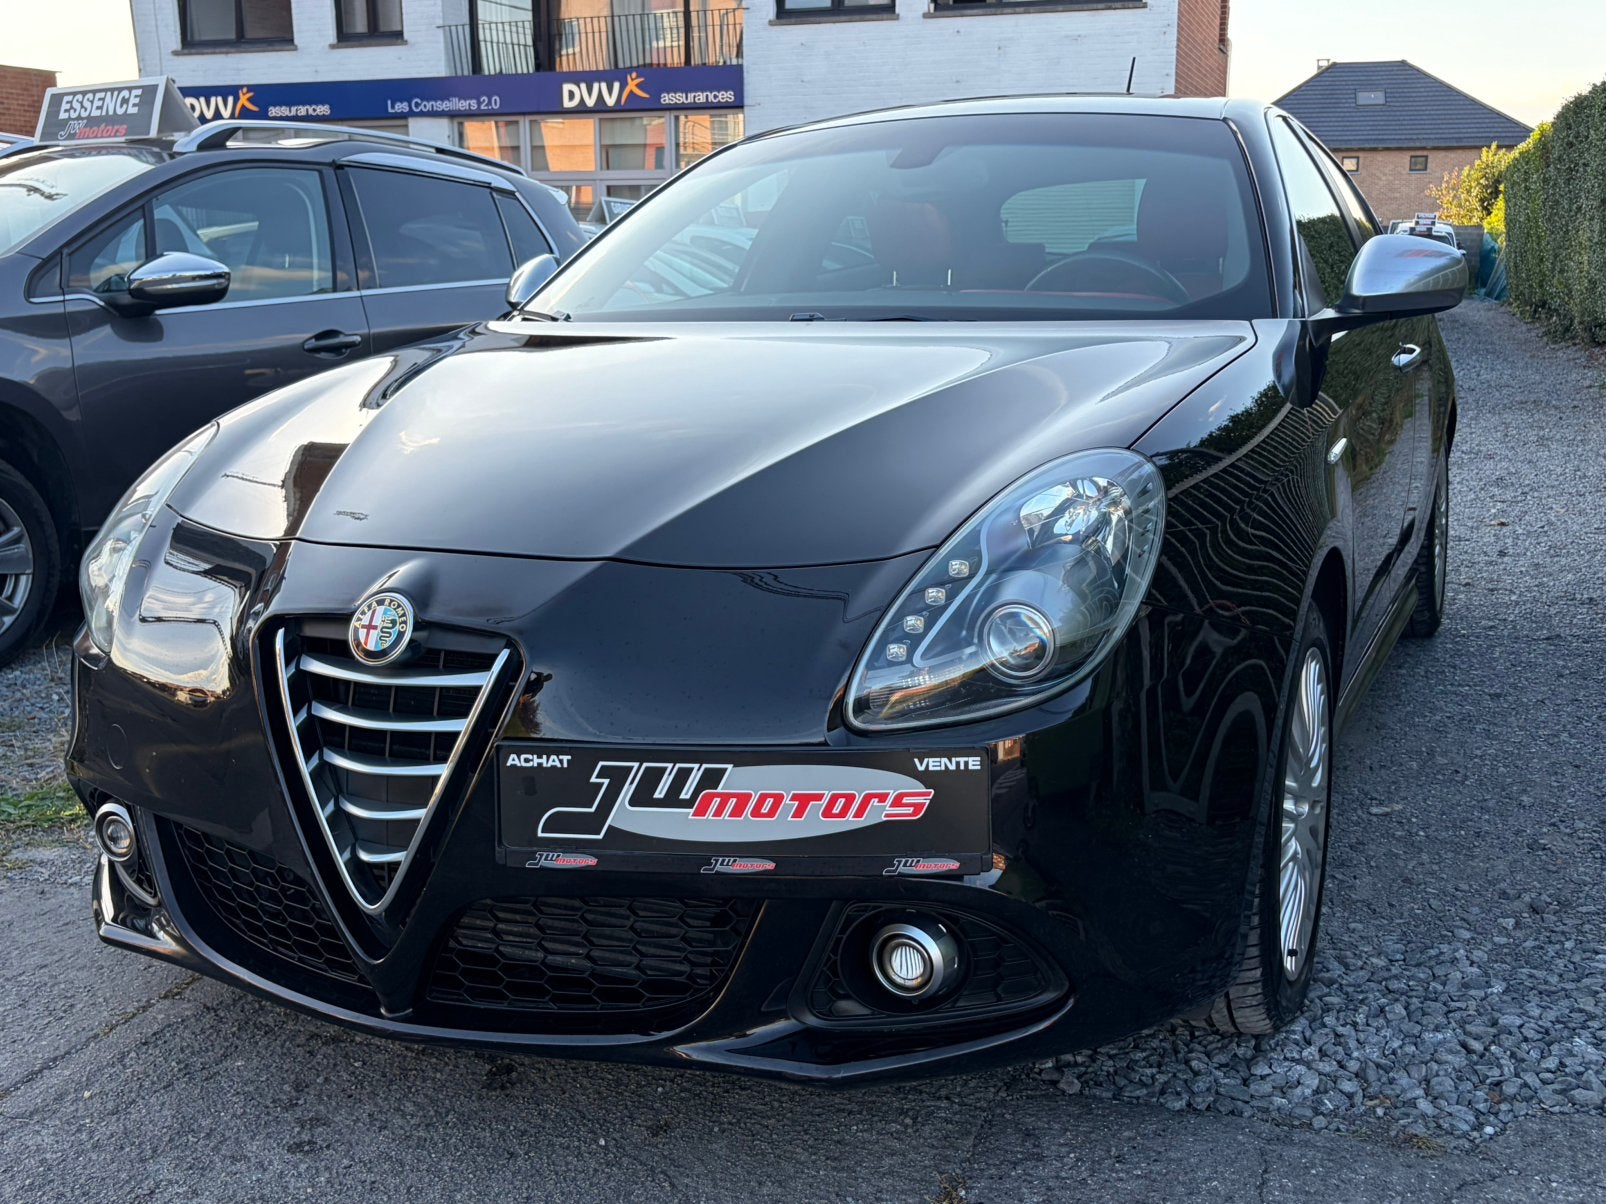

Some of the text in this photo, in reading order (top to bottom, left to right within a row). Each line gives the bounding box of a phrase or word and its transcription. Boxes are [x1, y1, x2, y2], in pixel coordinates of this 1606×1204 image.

[562, 80, 735, 109] DVV assurances
[58, 88, 143, 120] ESSENCE
[267, 104, 331, 117] assurances
[387, 95, 501, 113] Les Conseillers 2.0
[353, 598, 407, 632] ALFA ROMEO
[506, 753, 572, 768] ACHAT
[913, 756, 981, 772] VENTE
